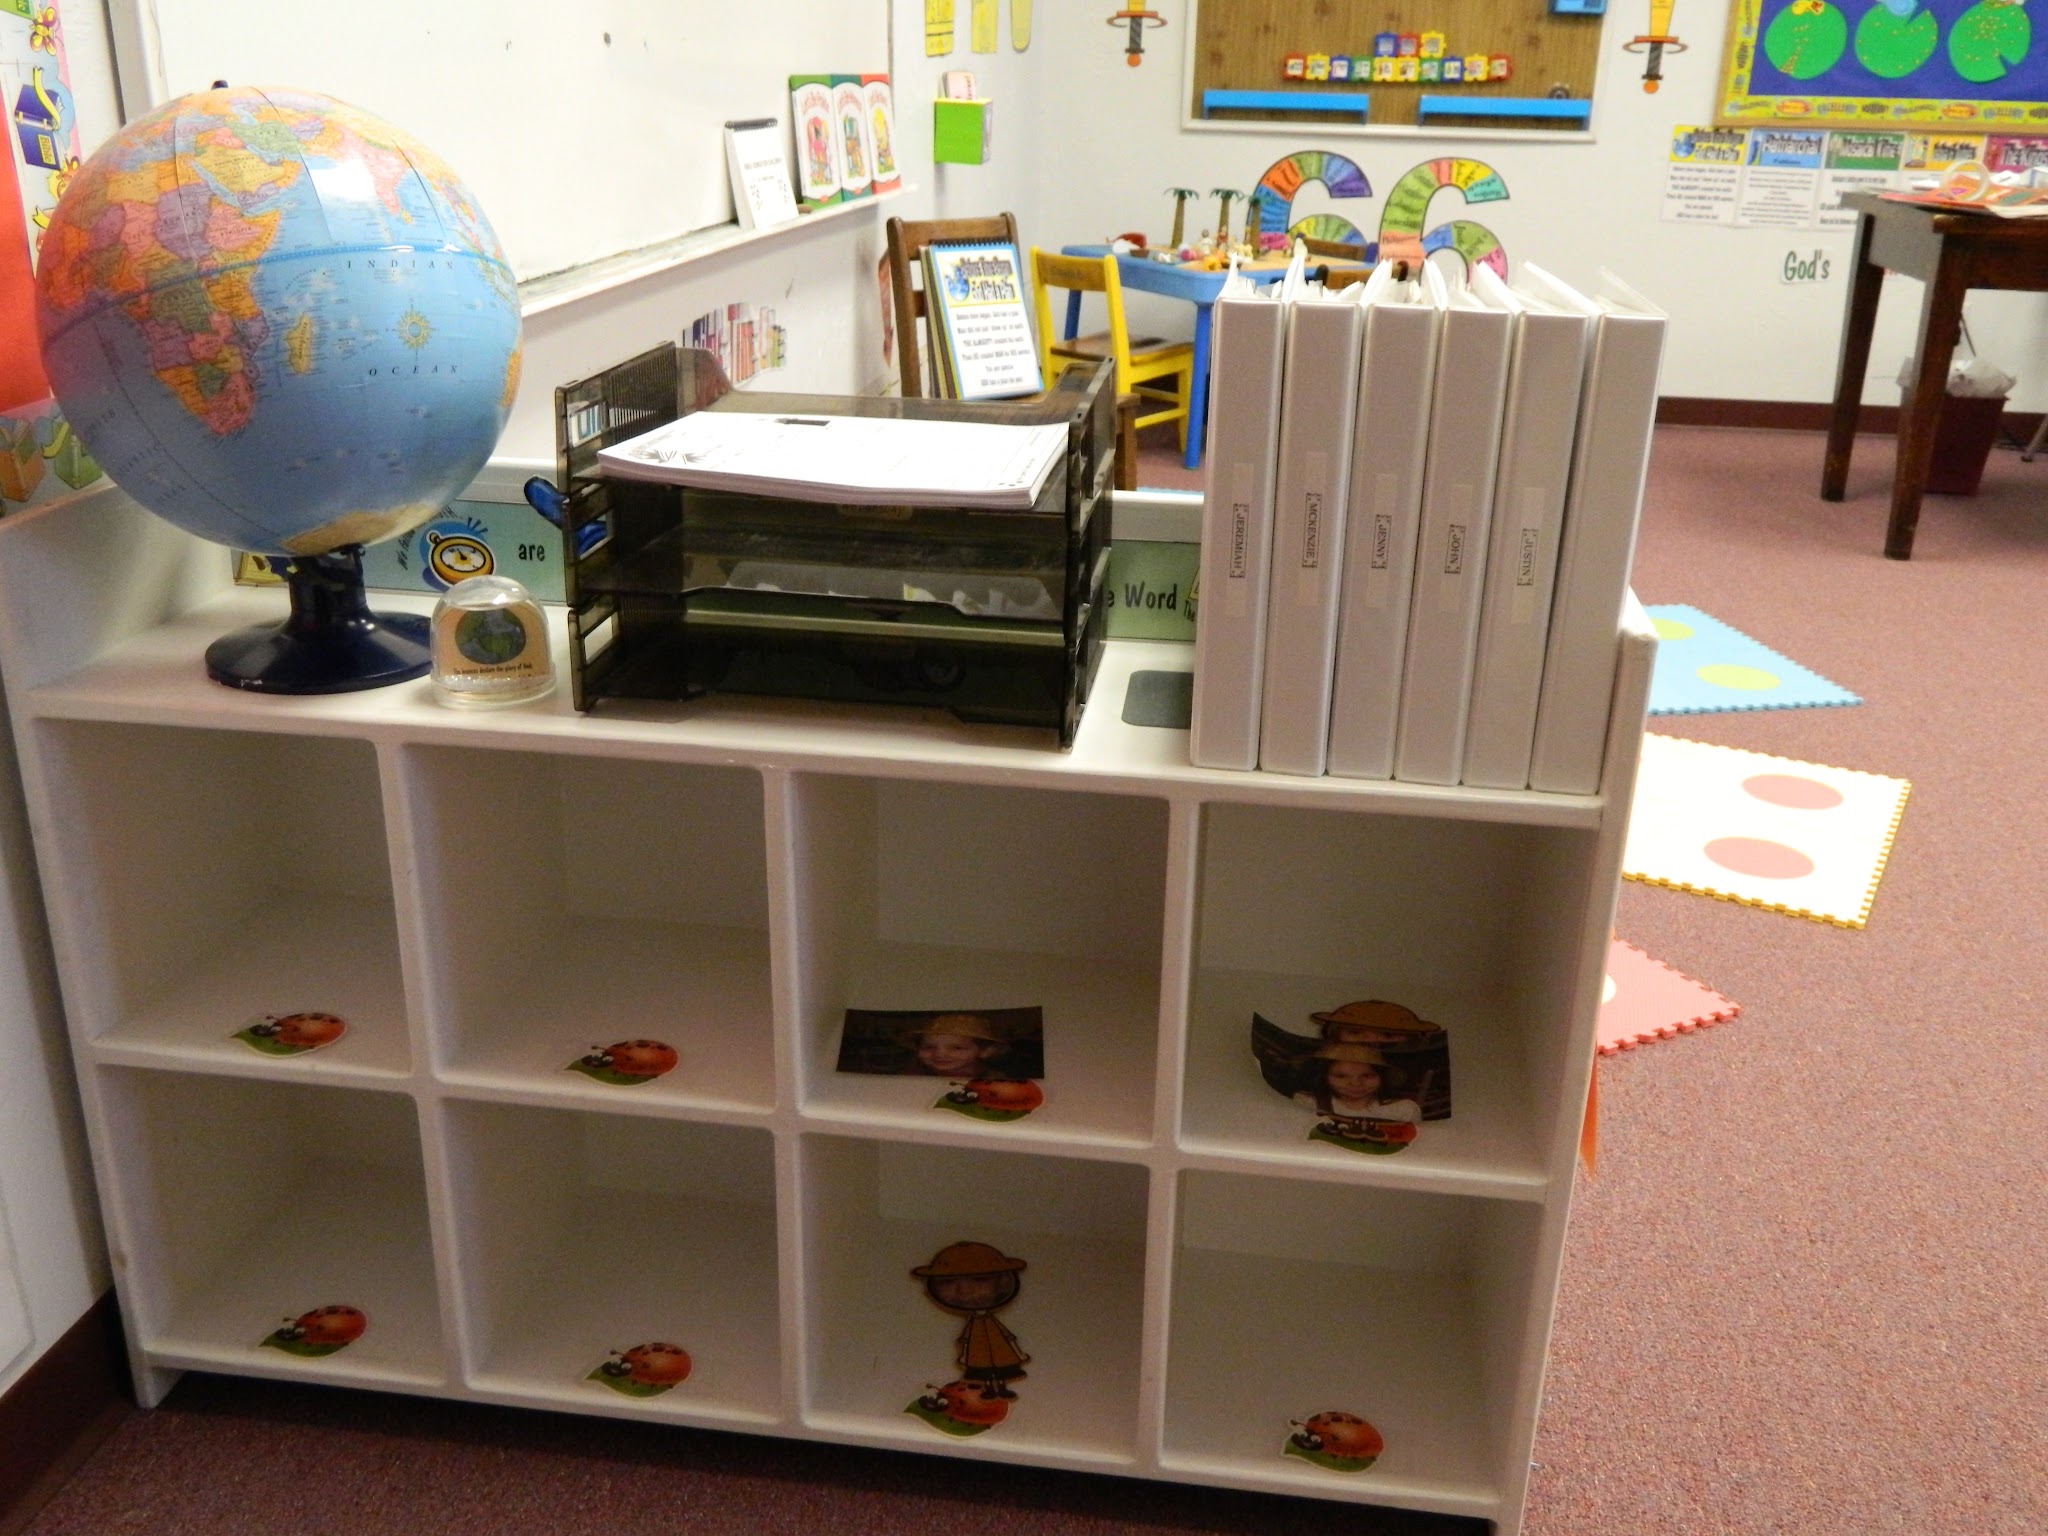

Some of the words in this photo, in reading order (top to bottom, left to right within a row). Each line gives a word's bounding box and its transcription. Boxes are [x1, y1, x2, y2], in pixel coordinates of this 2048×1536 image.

[41, 137, 53, 162] Bible
[347, 259, 454, 270] INDIAN
[1784, 249, 1830, 281] God's
[369, 365, 458, 377] OCEAN
[1233, 513, 1245, 569] JEREMIAH
[1306, 503, 1318, 558] MCKENZIE
[1376, 524, 1386, 558] JENNY
[519, 543, 545, 561] are
[1450, 533, 1460, 563] JOHN
[1522, 538, 1533, 576] JUSTIN
[1125, 580, 1178, 611] Word
